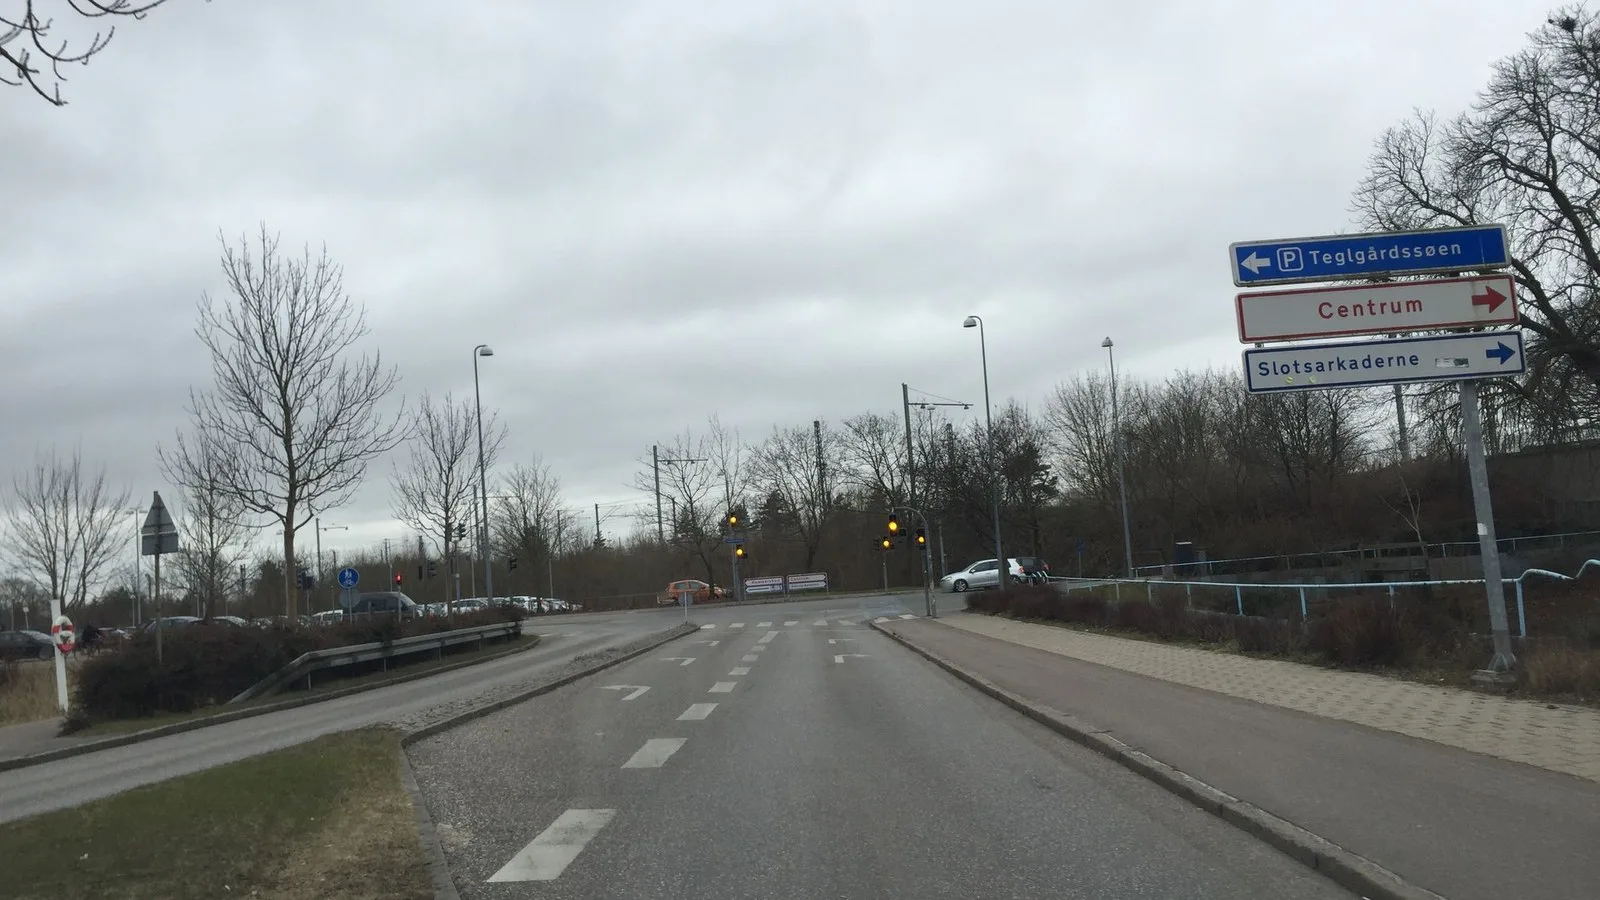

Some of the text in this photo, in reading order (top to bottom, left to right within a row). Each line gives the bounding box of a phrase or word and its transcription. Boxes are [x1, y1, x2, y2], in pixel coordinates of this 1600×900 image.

[1309, 242, 1462, 267] Teglgårdssøen
[1318, 297, 1424, 319] Centrum
[1258, 353, 1420, 377] Slotsarkaderne
